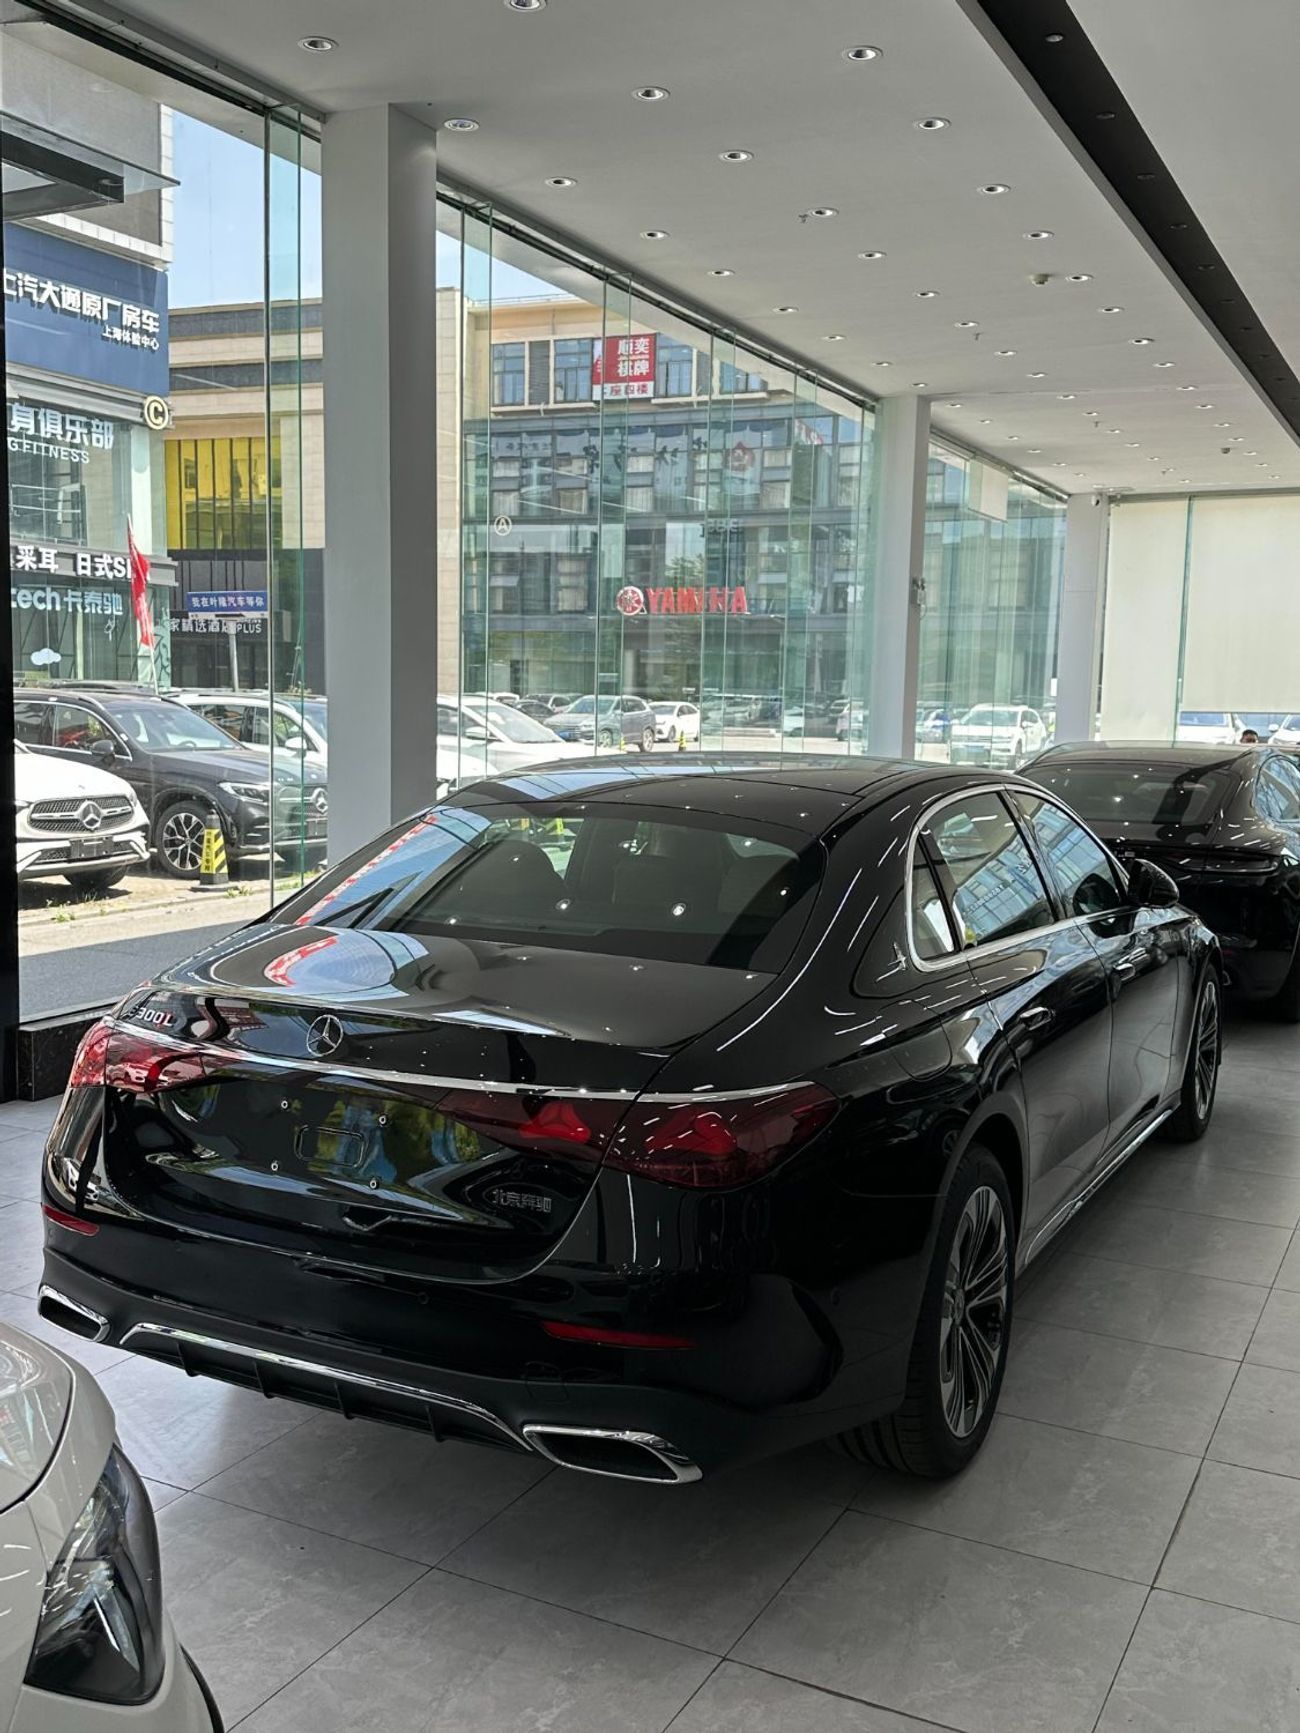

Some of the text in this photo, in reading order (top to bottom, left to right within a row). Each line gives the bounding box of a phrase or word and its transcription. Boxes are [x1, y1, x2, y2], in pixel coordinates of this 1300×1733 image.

[23, 439, 90, 464] FITNESS
[10, 544, 59, 574] 采耳
[236, 623, 262, 634] PLUS
[492, 1188, 552, 1214] 北京奔驰
